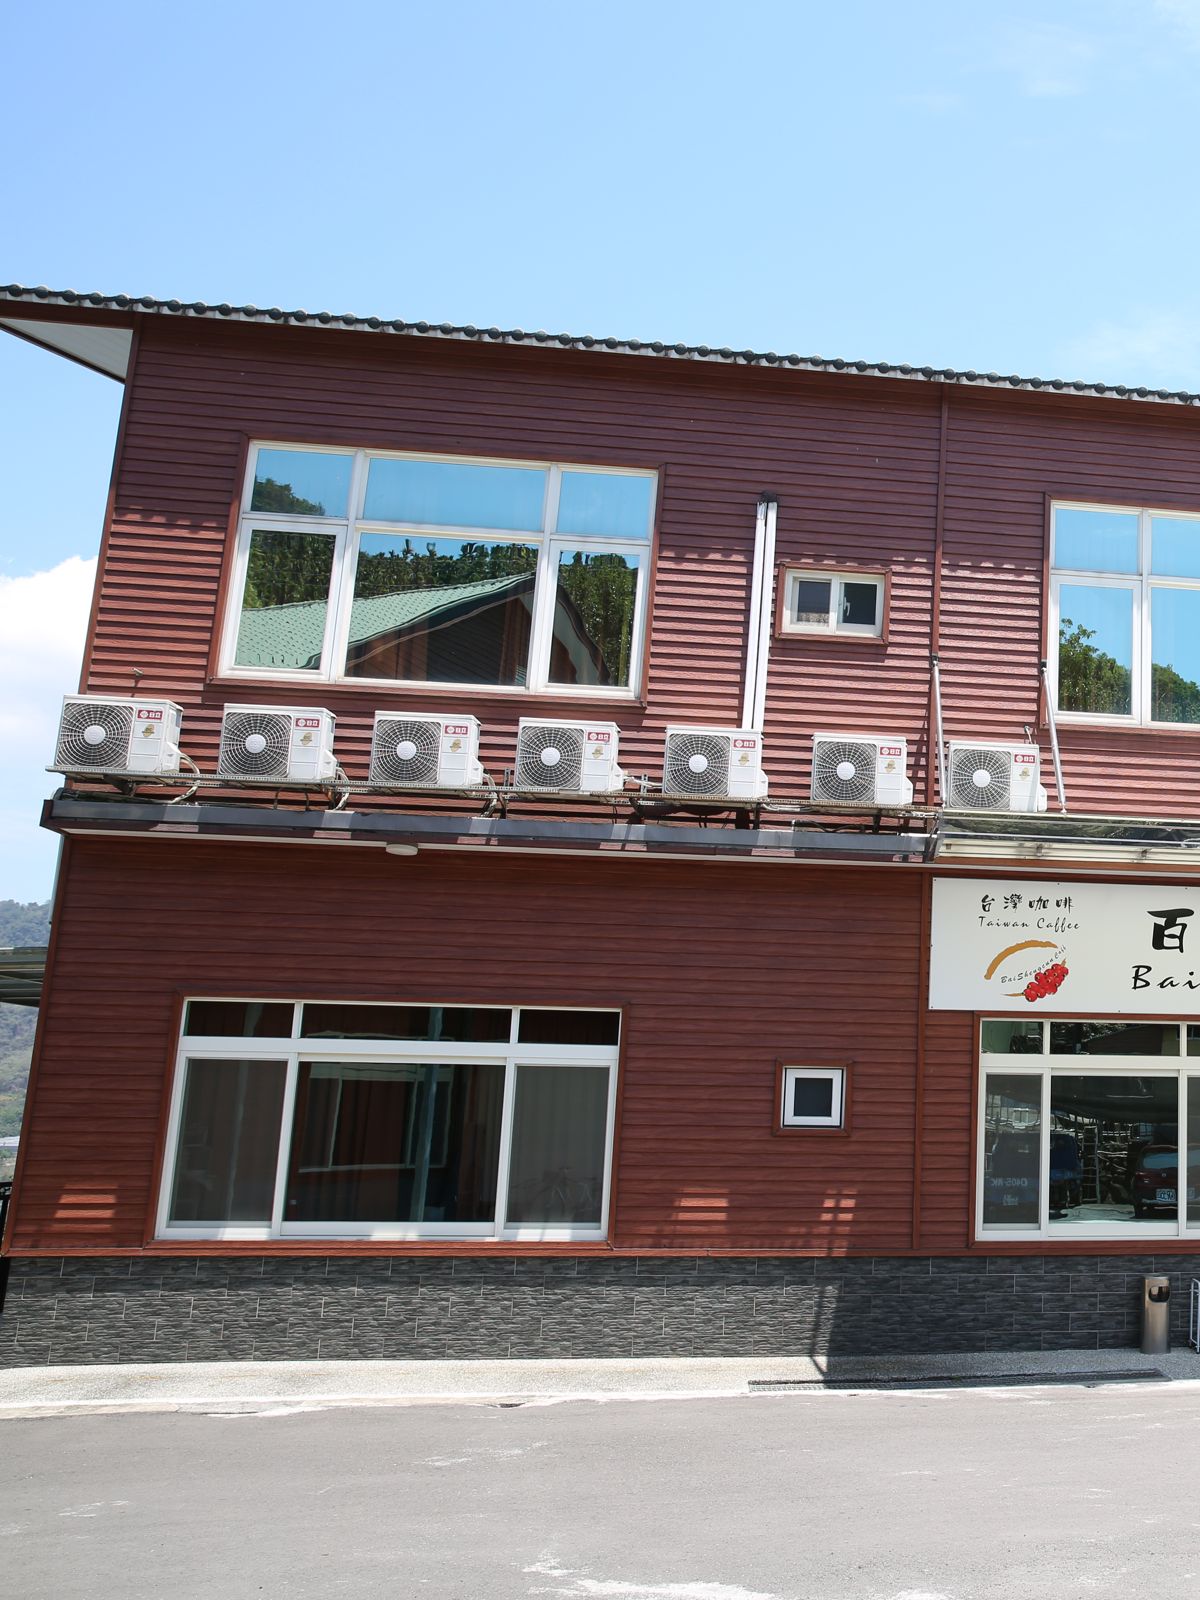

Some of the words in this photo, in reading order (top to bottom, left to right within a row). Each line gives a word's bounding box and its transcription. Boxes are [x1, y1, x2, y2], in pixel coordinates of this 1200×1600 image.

[981, 893, 1074, 913] 台灣咖啡
[978, 916, 1030, 928] Taiwan
